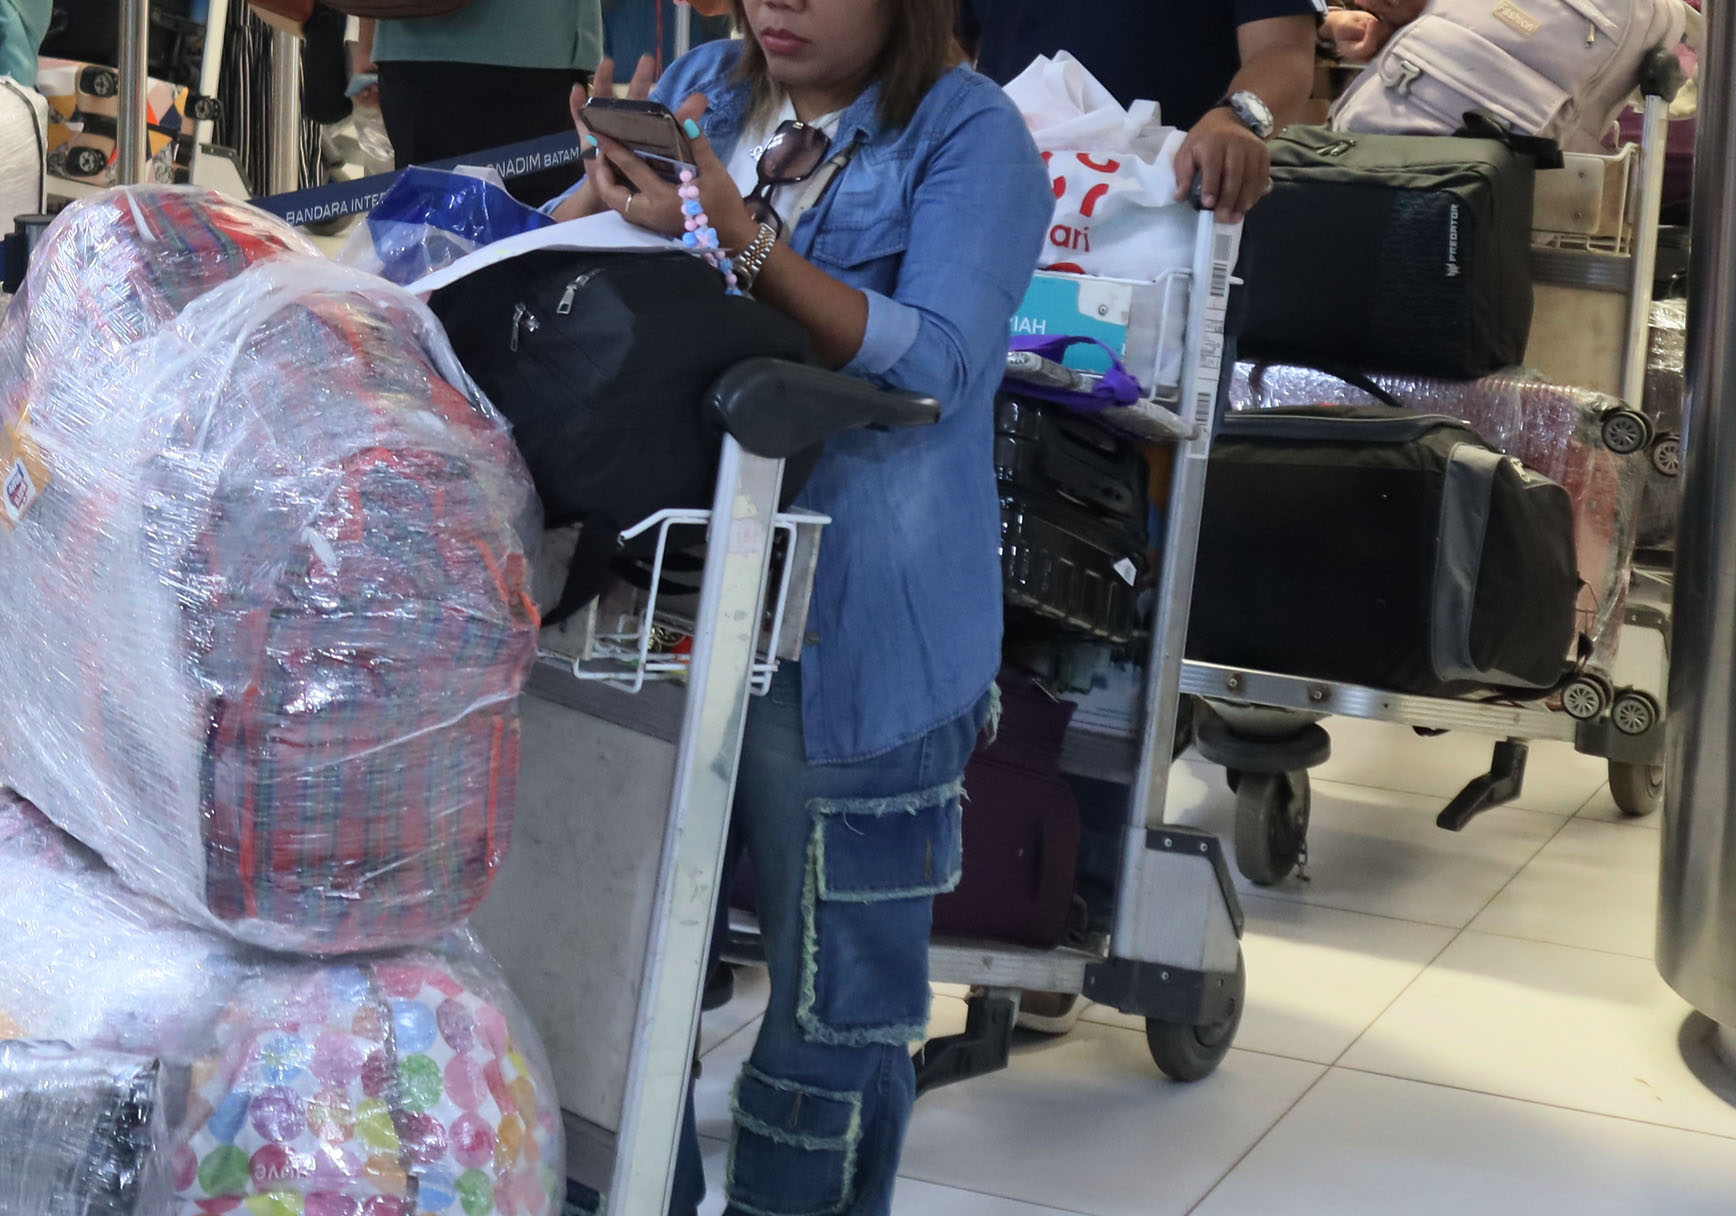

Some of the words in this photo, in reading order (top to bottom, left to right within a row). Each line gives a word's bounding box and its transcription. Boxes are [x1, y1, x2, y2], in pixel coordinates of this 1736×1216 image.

[543, 146, 580, 168] BATAM
[286, 200, 350, 225] BANDARA
[1448, 203, 1460, 262] PREDATOR
